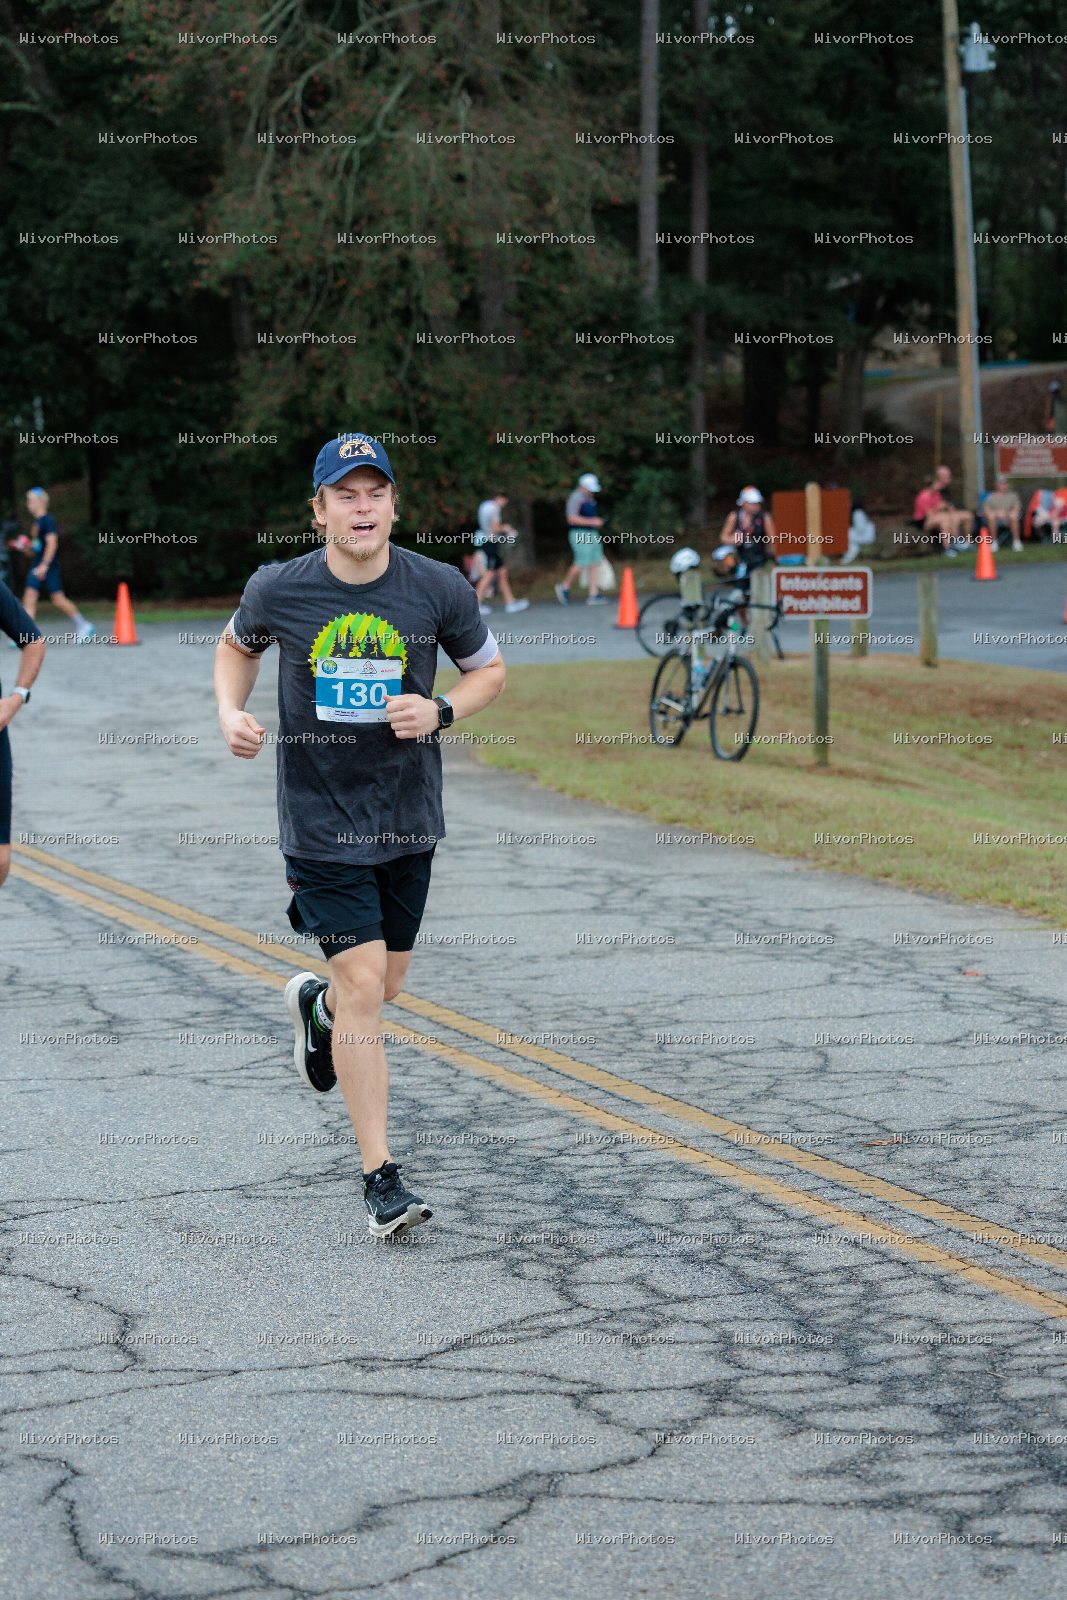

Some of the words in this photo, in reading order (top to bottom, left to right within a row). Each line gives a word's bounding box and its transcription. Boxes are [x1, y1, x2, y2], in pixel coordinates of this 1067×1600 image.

[781, 574, 864, 592] Intoxicants
[783, 594, 862, 612] Prohibited
[331, 681, 388, 707] 130
